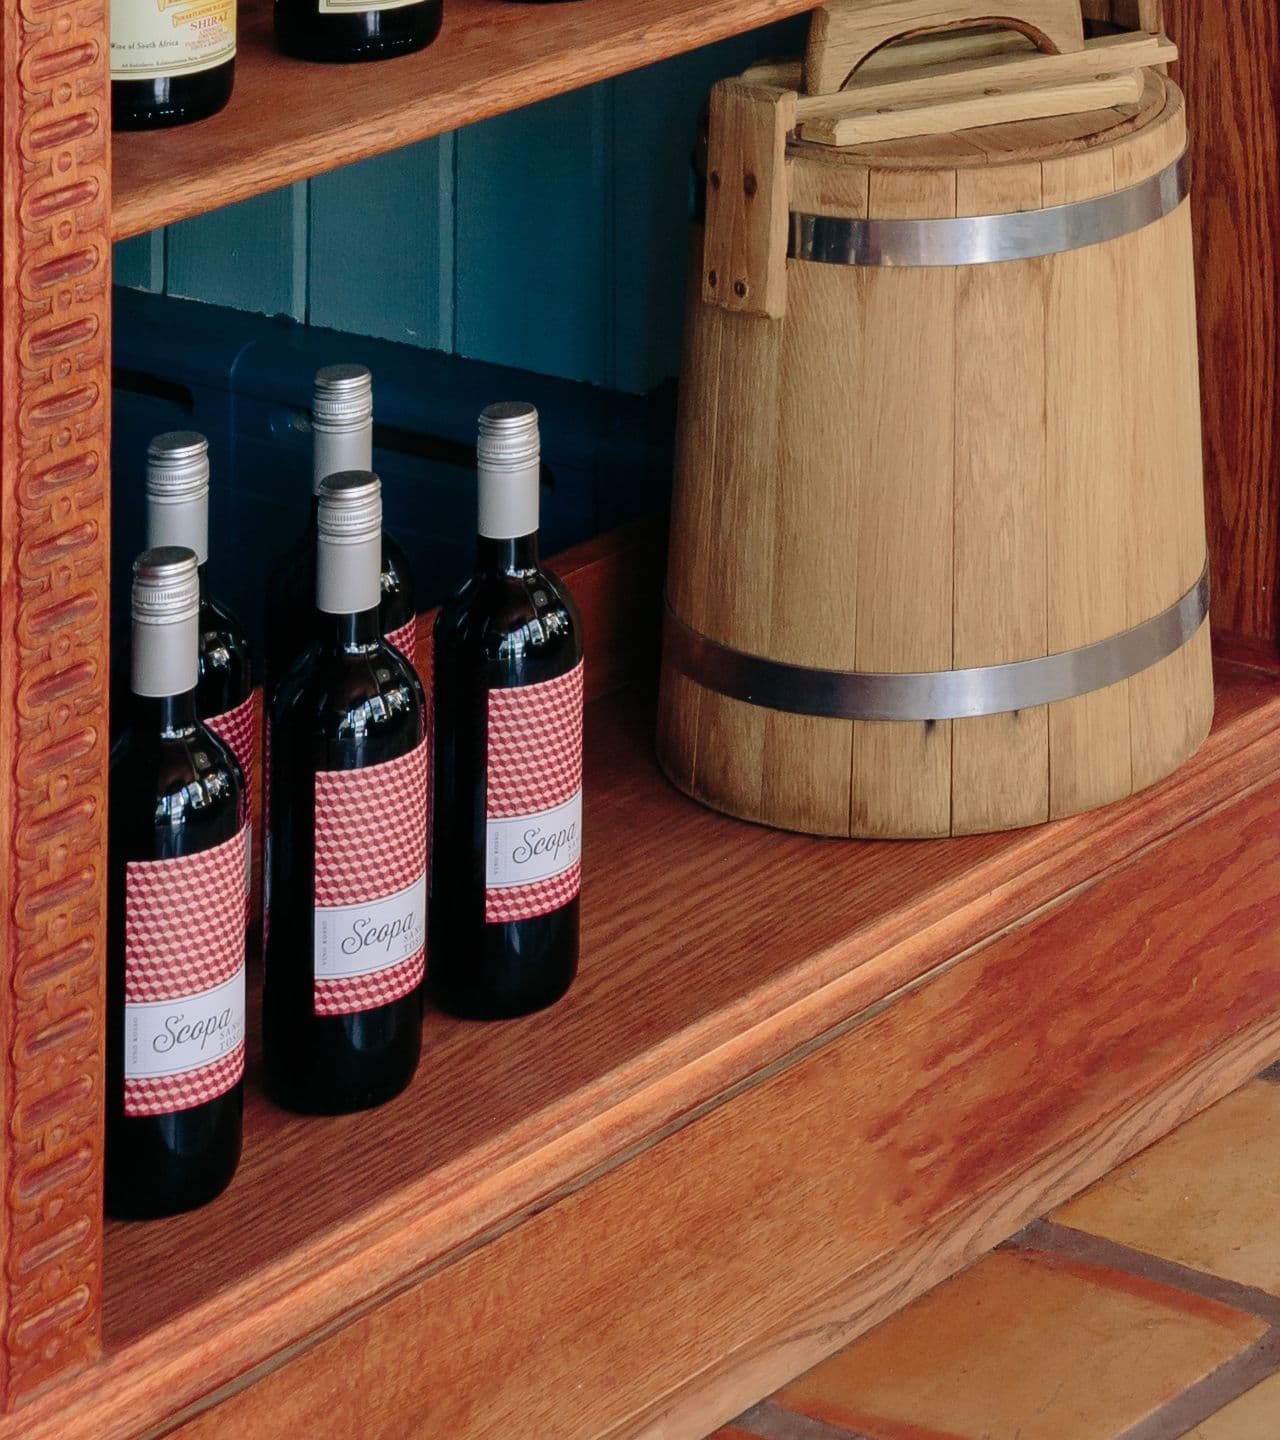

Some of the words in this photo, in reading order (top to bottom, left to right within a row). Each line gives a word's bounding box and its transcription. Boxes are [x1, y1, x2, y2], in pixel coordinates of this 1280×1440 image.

[190, 11, 229, 32] SHIRAZ
[111, 42, 126, 50] Wine
[128, 42, 135, 50] of
[137, 41, 156, 50] South
[158, 40, 179, 48] Africa
[513, 821, 576, 864] Scopa
[341, 911, 415, 955] Scopa
[153, 1007, 233, 1053] Scopa
